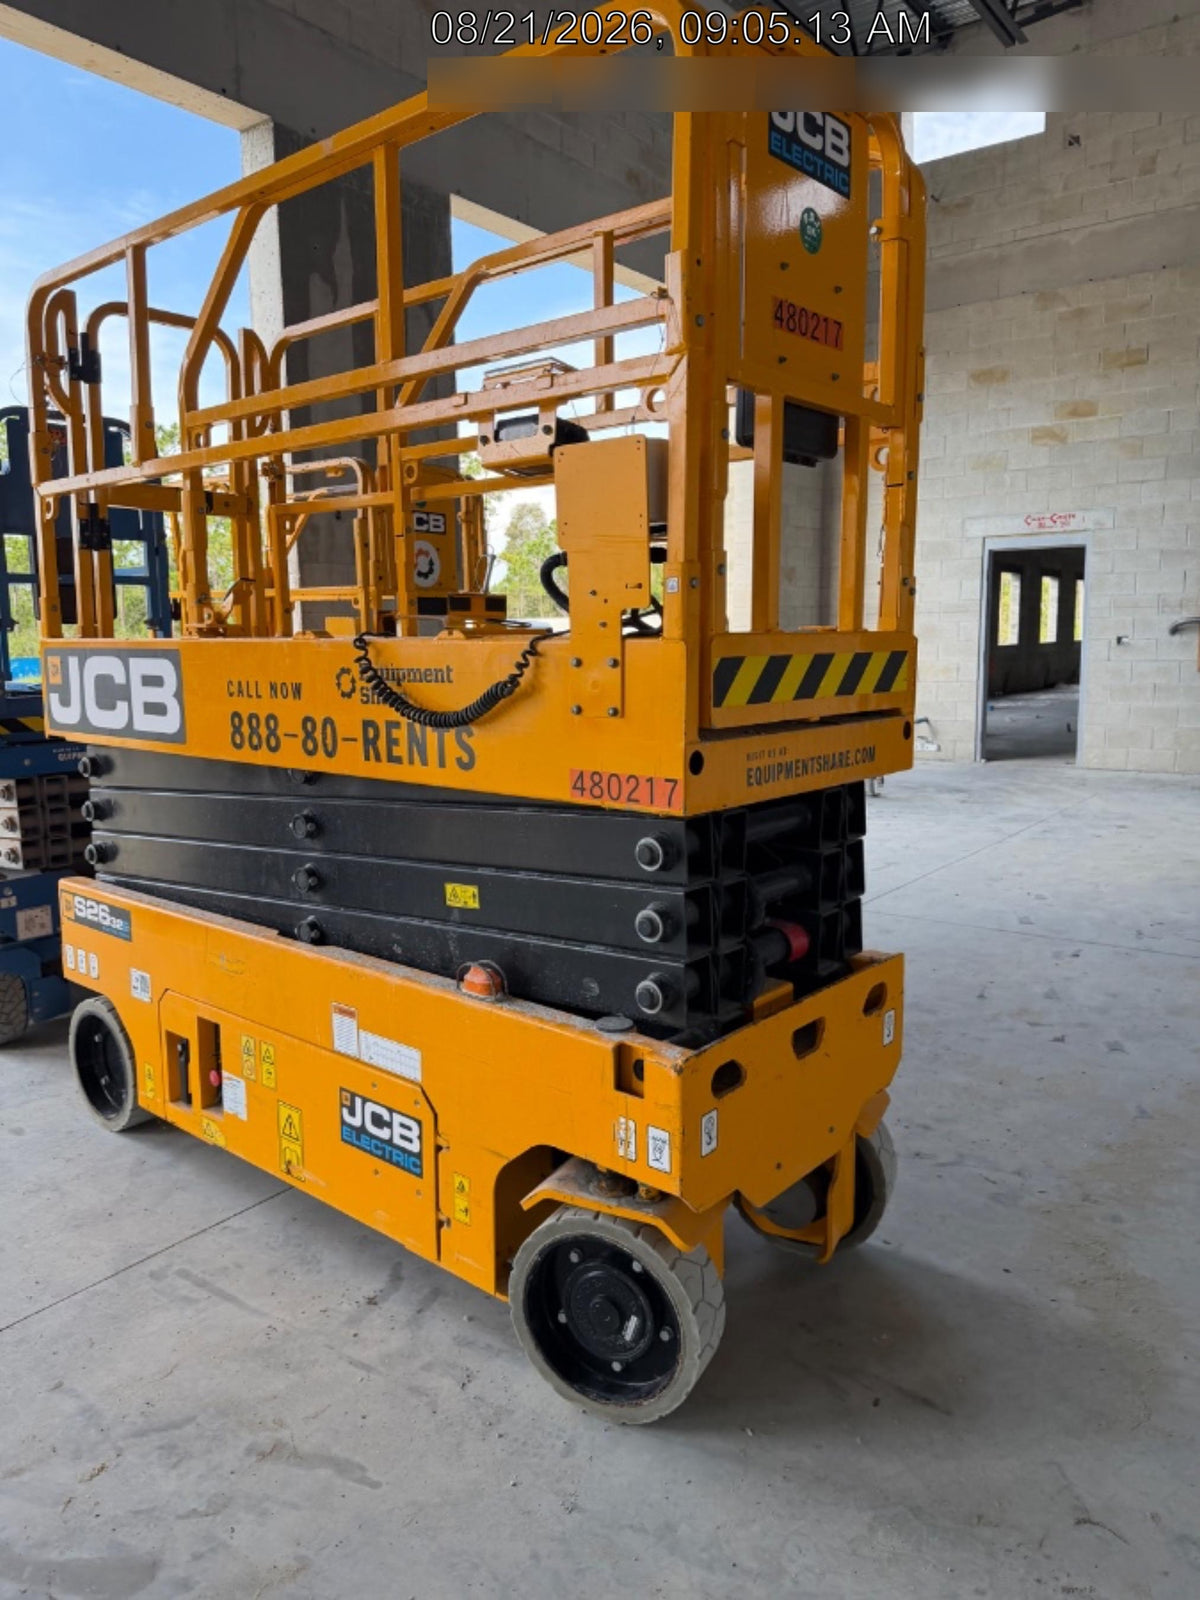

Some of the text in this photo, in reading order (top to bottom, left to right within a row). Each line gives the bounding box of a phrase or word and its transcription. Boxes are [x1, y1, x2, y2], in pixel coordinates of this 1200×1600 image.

[770, 131, 849, 193] ELECTRIC
[774, 300, 842, 348] 480217
[414, 512, 445, 532] CB
[49, 656, 180, 734] JCB
[227, 680, 302, 700] CALL NOW
[361, 665, 453, 686] uipment
[230, 710, 476, 771] 888-80-RENTS
[572, 770, 678, 808] 480217
[746, 746, 876, 786] EQUIPMENTSHARE.COM
[342, 1096, 420, 1153] JCB
[342, 1125, 421, 1175] ELECTRIC
